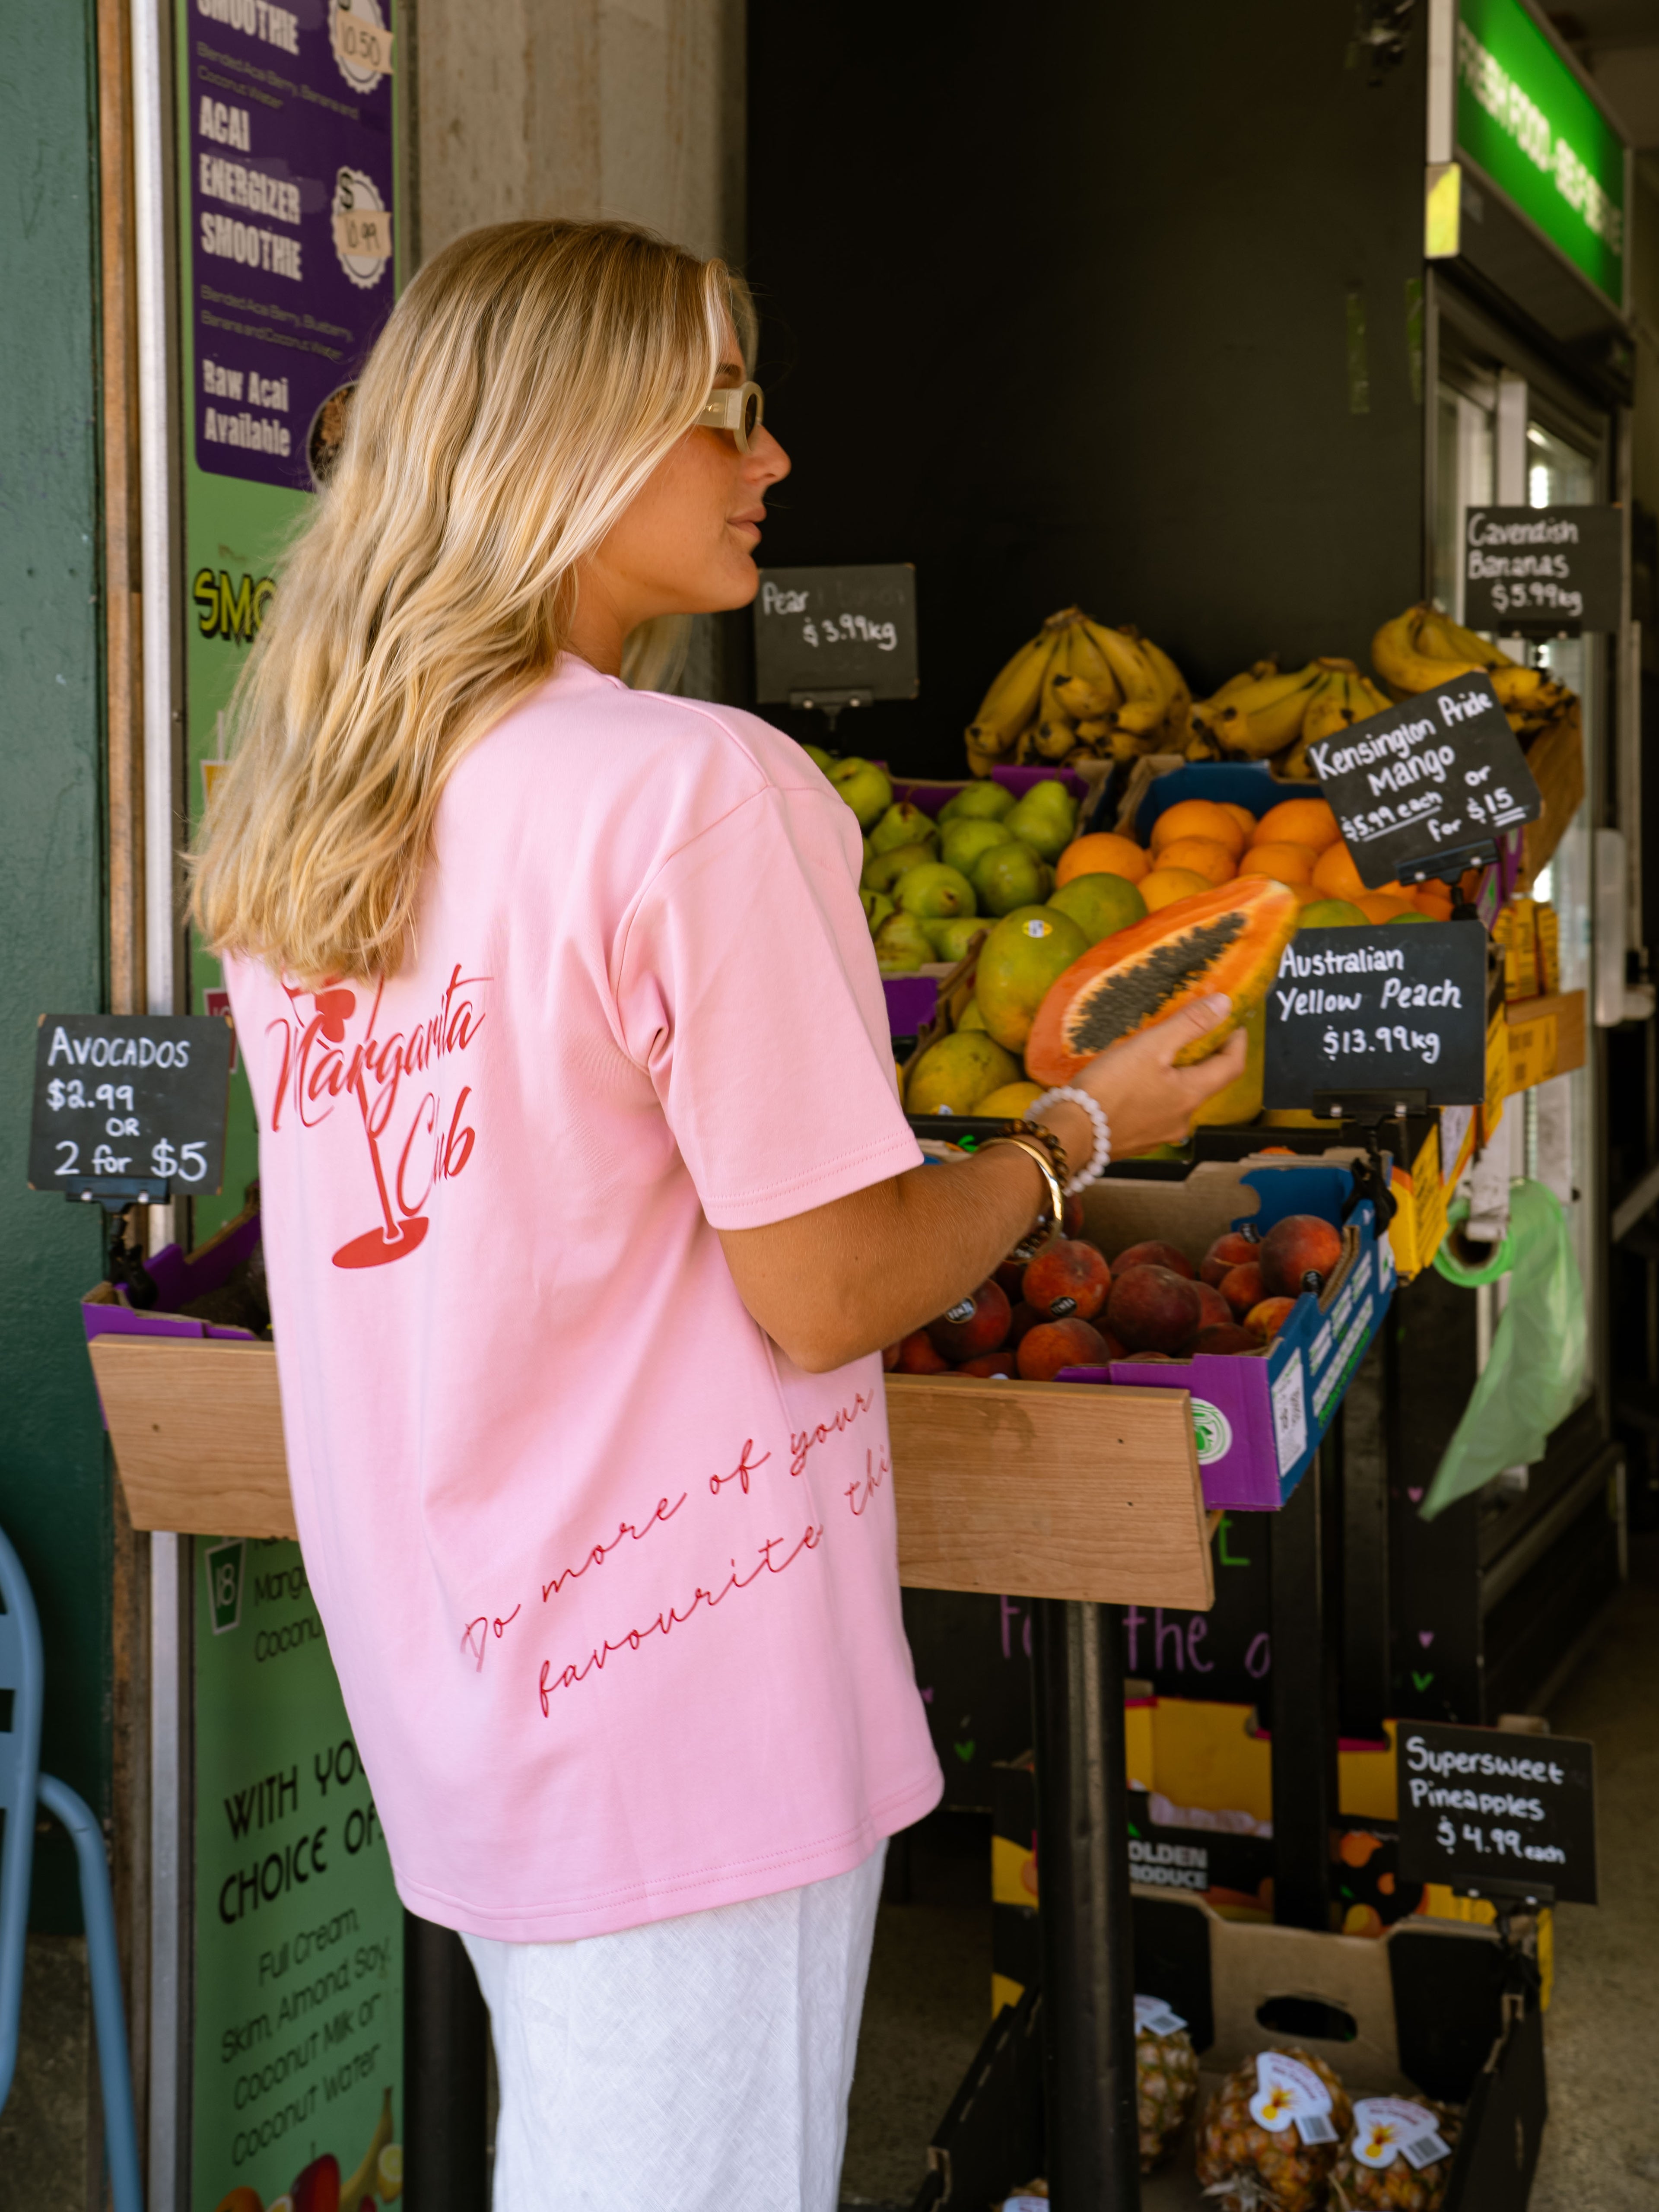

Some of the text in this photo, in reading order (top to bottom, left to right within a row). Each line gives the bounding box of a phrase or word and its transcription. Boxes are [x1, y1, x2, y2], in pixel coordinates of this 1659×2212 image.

[199, 95, 250, 152] ACAI
[200, 153, 301, 225] ENERGIZER
[201, 211, 302, 282] SMOOTHIE
[202, 359, 289, 413] Raw Acai
[204, 407, 291, 458] Available
[1469, 512, 1580, 547] Cavendish
[1468, 549, 1570, 579] Bananas
[763, 582, 809, 616] Pear
[1437, 692, 1493, 727] Pride
[1367, 745, 1456, 797] Mango
[1341, 766, 1491, 842] $5.99 each or
[1427, 787, 1513, 842] for $15
[1277, 943, 1404, 978] Australian
[1276, 977, 1462, 1022] Yellow Peach
[47, 1026, 191, 1068] AVOCADOS
[46, 1078, 133, 1112] $2.99
[54, 1138, 208, 1182] 2 for $5
[461, 1387, 874, 1673] Do more of your
[538, 1524, 823, 1719] favourite
[1122, 1605, 1215, 1673] the
[1405, 1736, 1564, 1785] Supersweet
[223, 1764, 298, 1841] WITH
[1409, 1778, 1546, 1822] Pineapples
[219, 1825, 328, 1924] CHOICE
[234, 2031, 319, 2110] Coconut
[232, 2085, 318, 2167] Coconut
